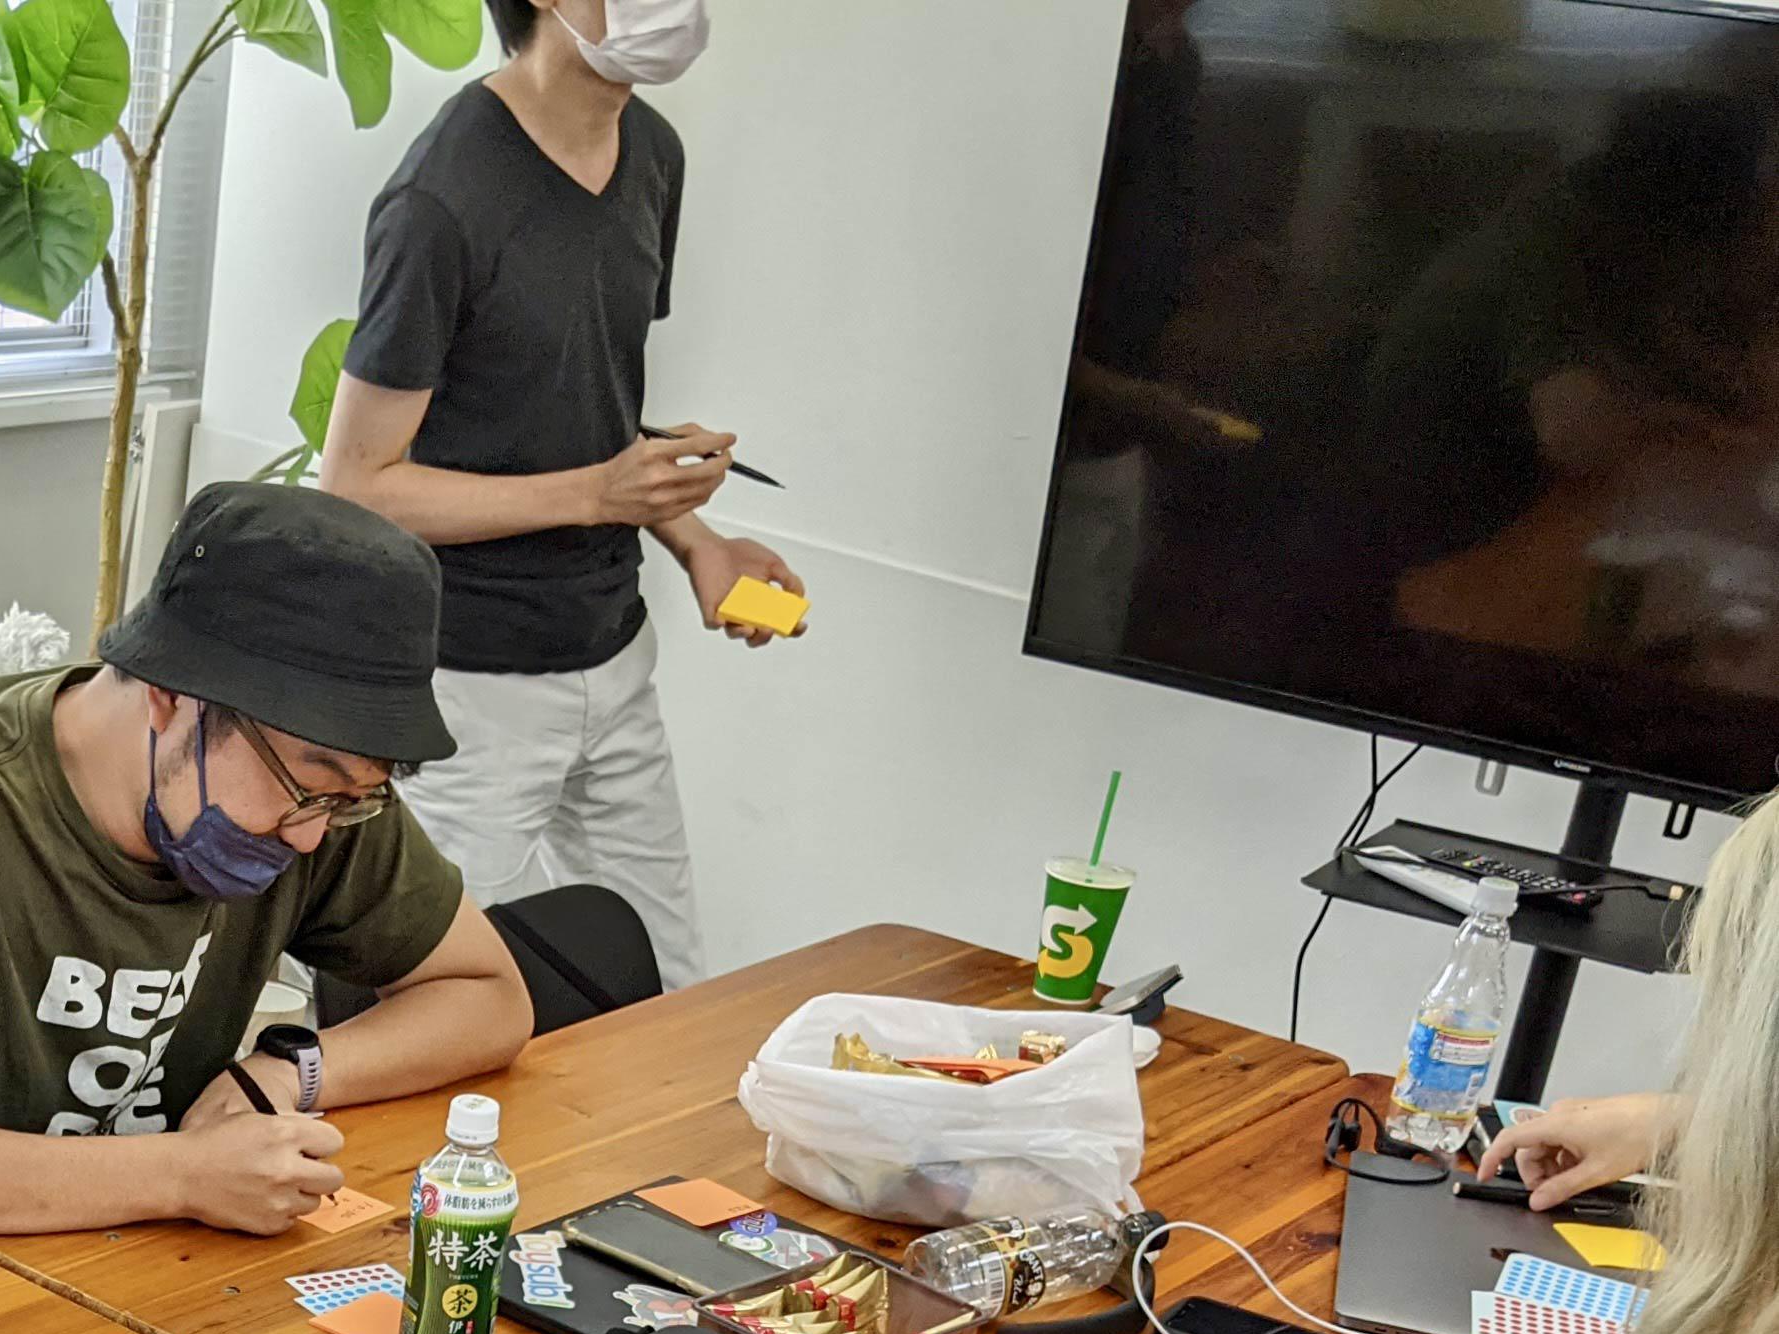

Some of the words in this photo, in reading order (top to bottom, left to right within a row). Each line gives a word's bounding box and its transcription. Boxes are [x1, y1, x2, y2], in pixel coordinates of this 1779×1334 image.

[427, 1228, 501, 1271] 特茶
[514, 1233, 572, 1307] Toysub!
[447, 1287, 473, 1313] 茶
